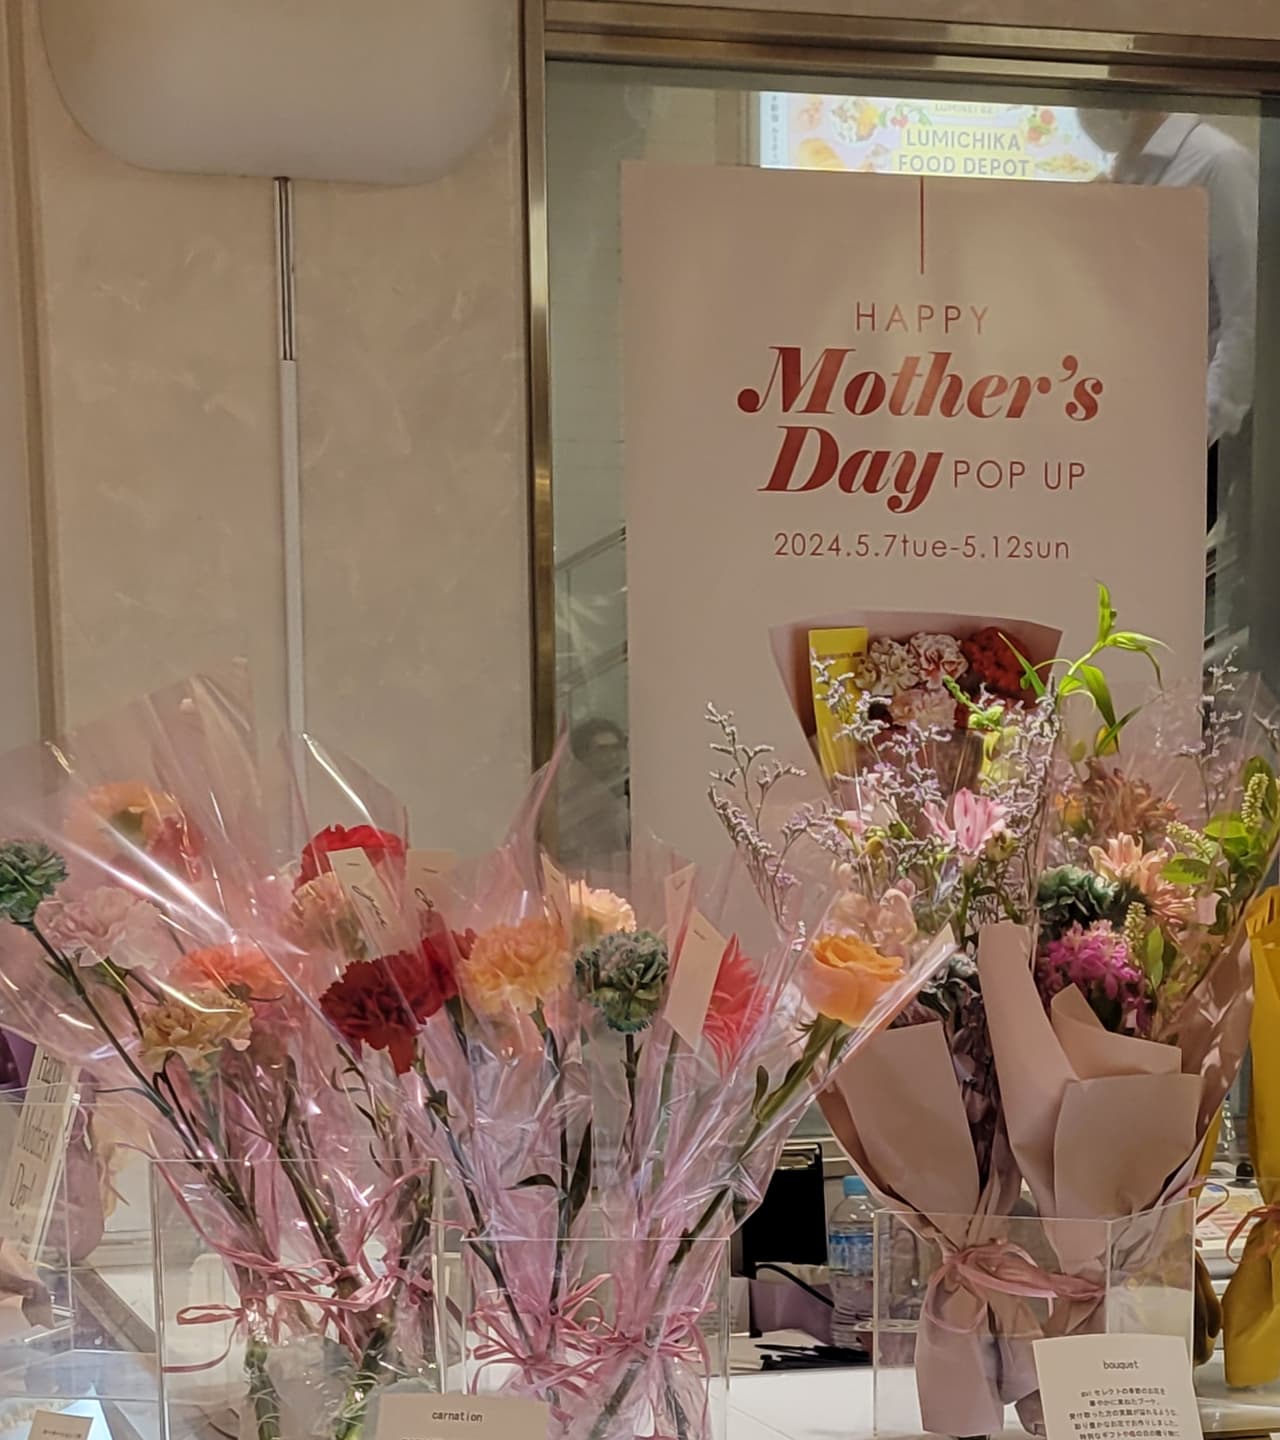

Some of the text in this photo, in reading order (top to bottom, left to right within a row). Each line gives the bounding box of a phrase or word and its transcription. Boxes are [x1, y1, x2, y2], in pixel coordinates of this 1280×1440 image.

[905, 128, 1021, 152] LUMICHIKA
[897, 153, 1030, 178] FOOD DEPOT
[854, 301, 990, 334] HAPPY
[736, 345, 1104, 422] Mother's
[756, 424, 1086, 514] Day POP UP
[773, 531, 1070, 560] 2024.5.7tue-5.12sun
[1102, 1359, 1140, 1371] bouquet
[431, 1410, 484, 1424] carnation
